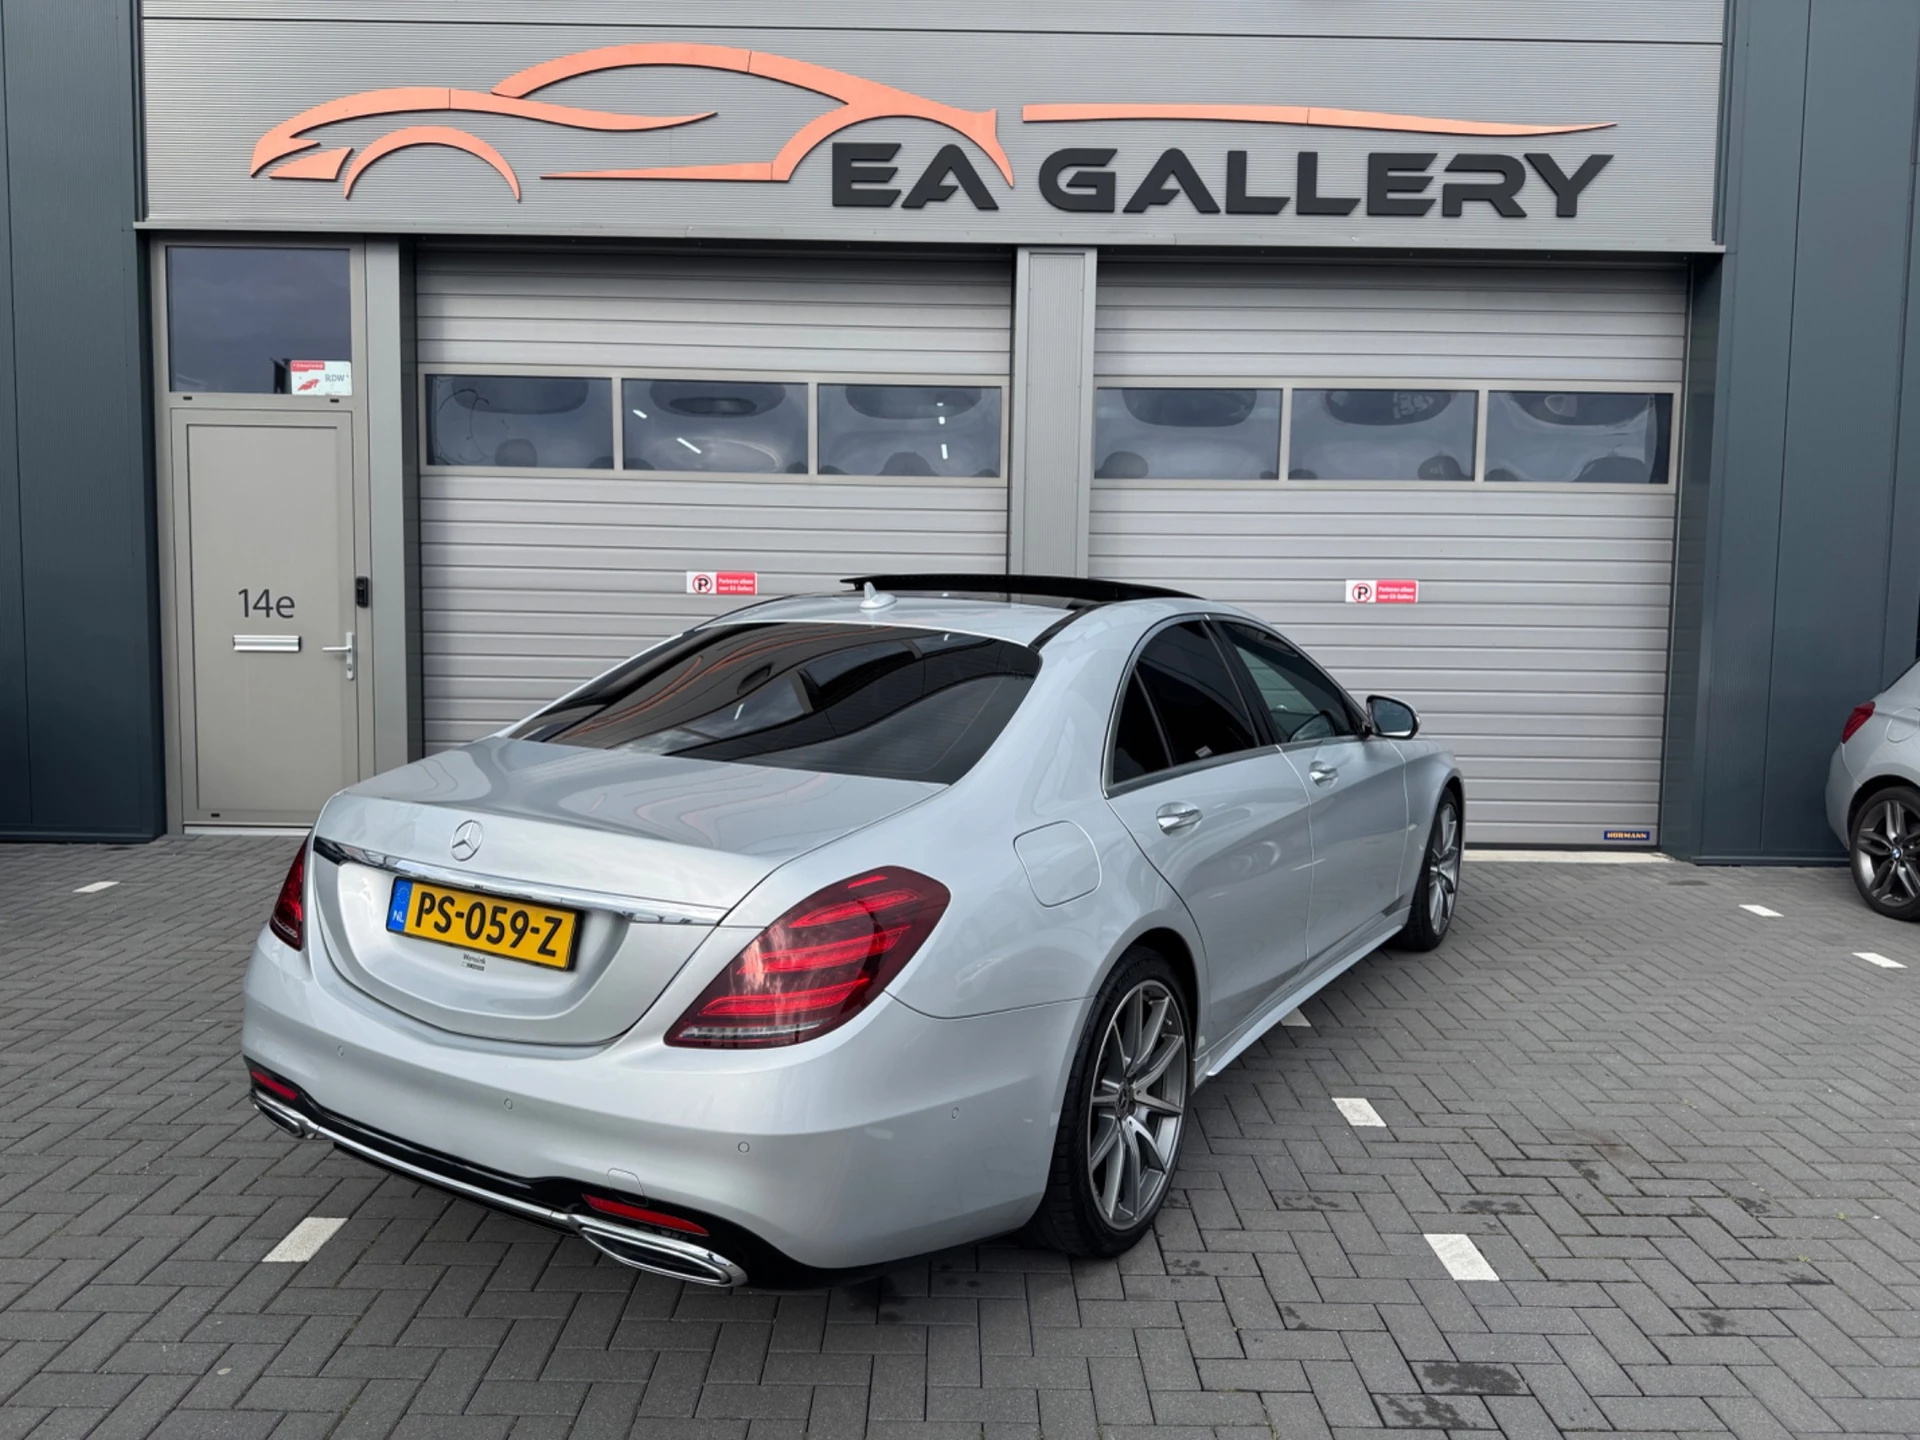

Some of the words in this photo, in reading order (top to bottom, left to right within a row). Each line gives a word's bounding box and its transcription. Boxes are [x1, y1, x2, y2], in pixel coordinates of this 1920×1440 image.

[832, 142, 998, 210] EA
[1038, 147, 1614, 218] GALLERY
[238, 588, 295, 619] 14e
[392, 910, 405, 923] NL
[415, 891, 563, 957] PS-059-Z
